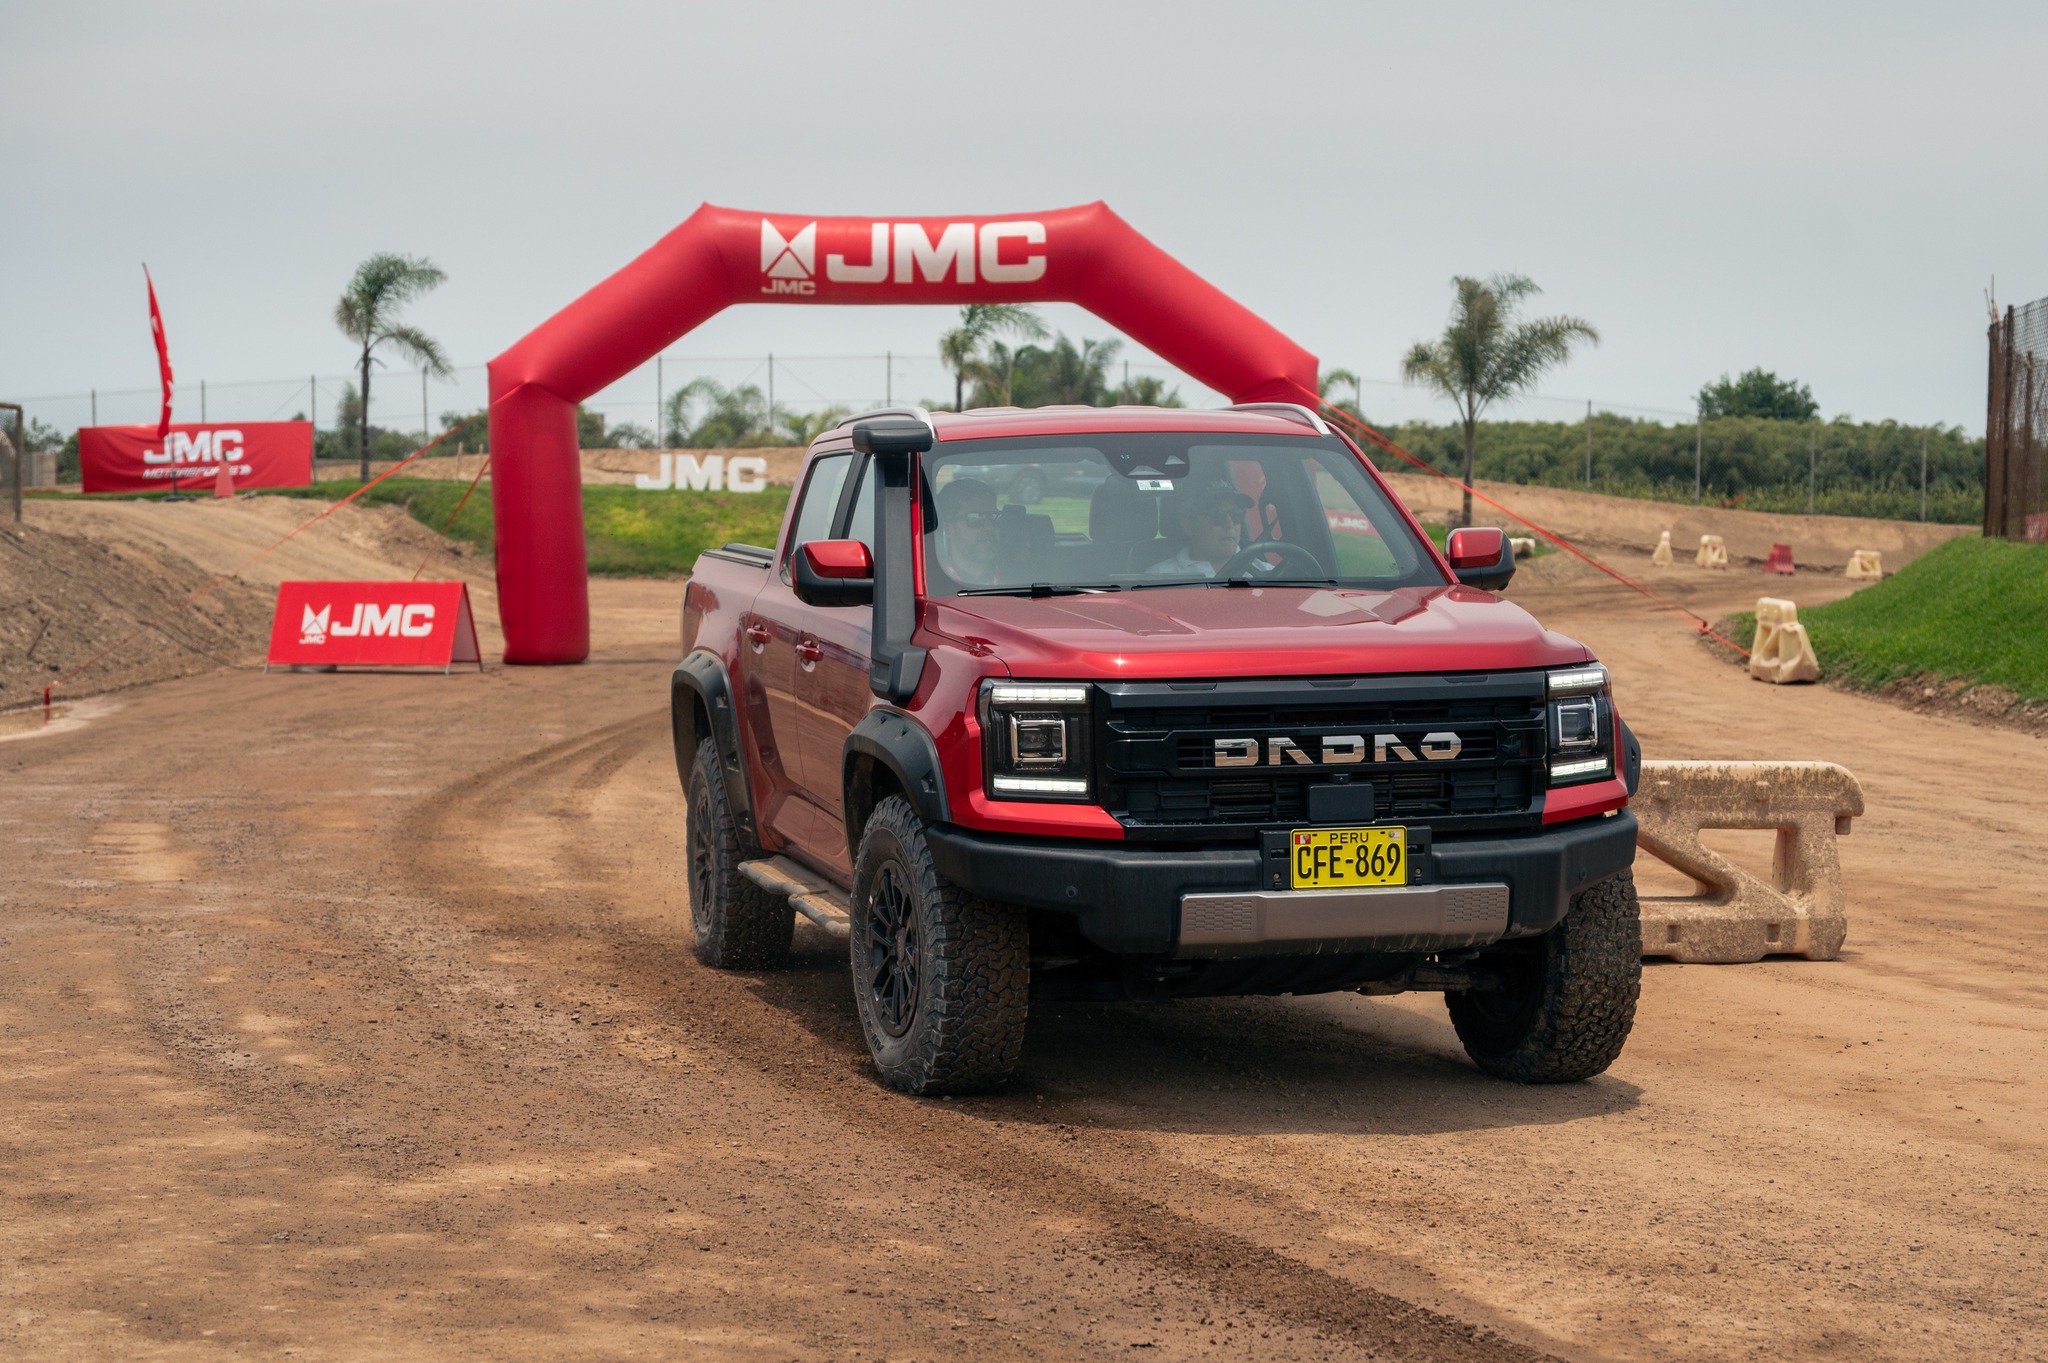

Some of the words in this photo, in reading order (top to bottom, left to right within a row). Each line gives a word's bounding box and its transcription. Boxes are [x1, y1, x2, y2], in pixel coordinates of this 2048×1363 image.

[825, 221, 1047, 284] JMC
[761, 279, 816, 296] JMC
[143, 429, 244, 465] JMC
[142, 465, 240, 479] MOTORSPORS
[635, 453, 767, 493] JMC
[330, 602, 436, 637] JMC
[299, 634, 326, 645] JMC
[1329, 832, 1369, 844] PERU
[1297, 843, 1401, 879] CFE-869
